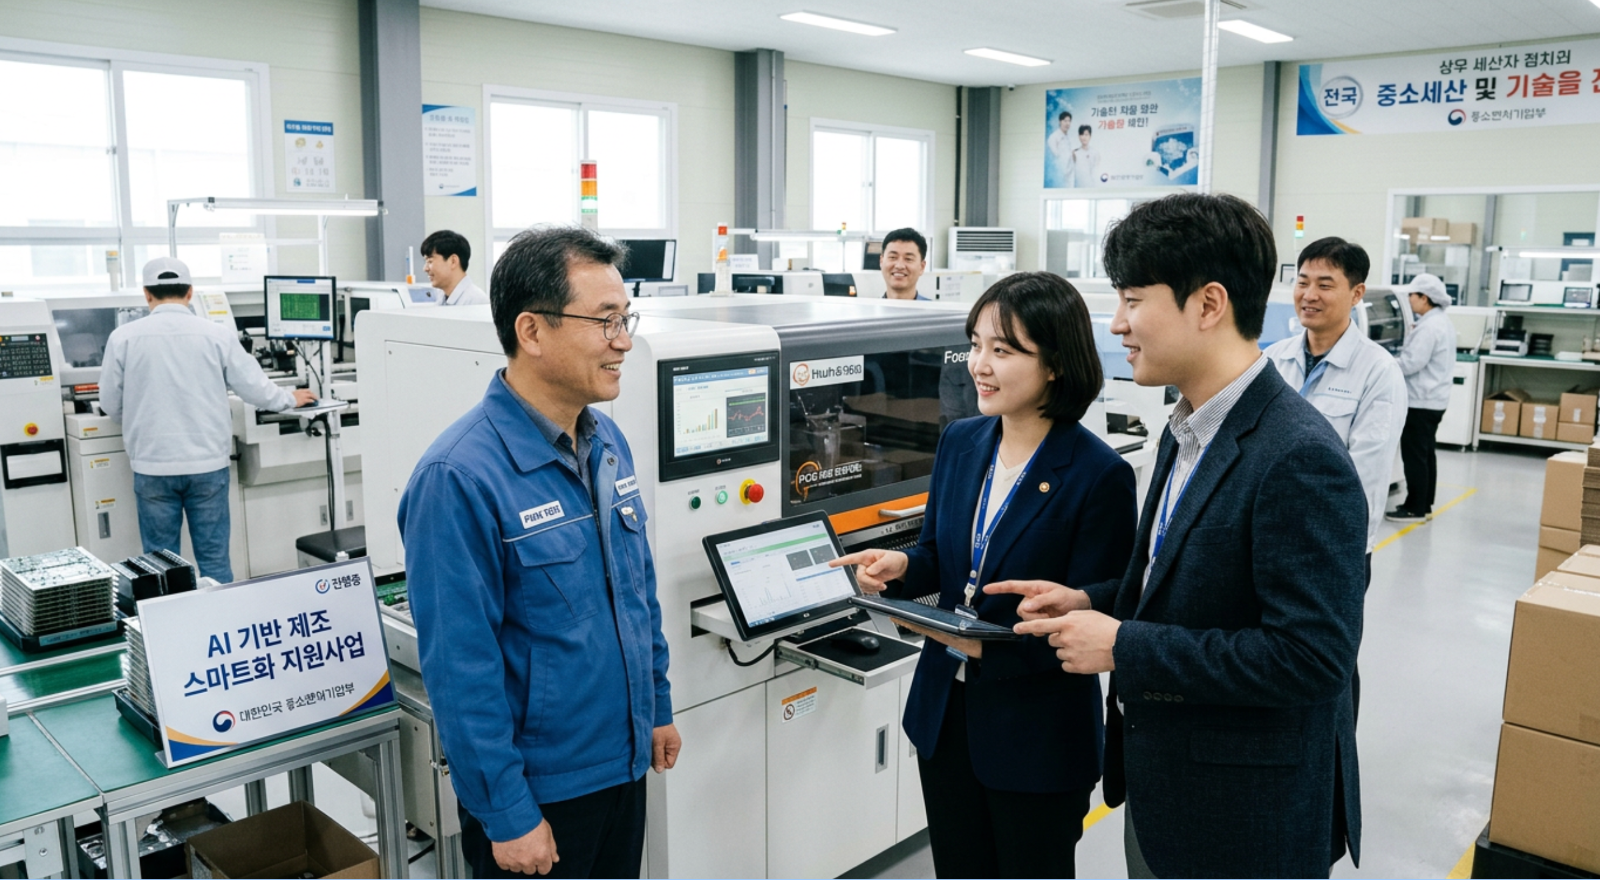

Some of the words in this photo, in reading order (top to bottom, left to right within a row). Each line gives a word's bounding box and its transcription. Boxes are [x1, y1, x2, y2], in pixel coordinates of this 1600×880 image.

[1323, 86, 1357, 107] 전국
[1376, 79, 1467, 107] 중소세산
[1475, 77, 1497, 101] 및
[1506, 70, 1582, 98] 기술을
[207, 632, 232, 658] AI
[237, 618, 283, 650] 기반
[287, 609, 332, 639] 제조
[183, 652, 276, 697] 스마트화
[281, 631, 366, 673] 지원사업
